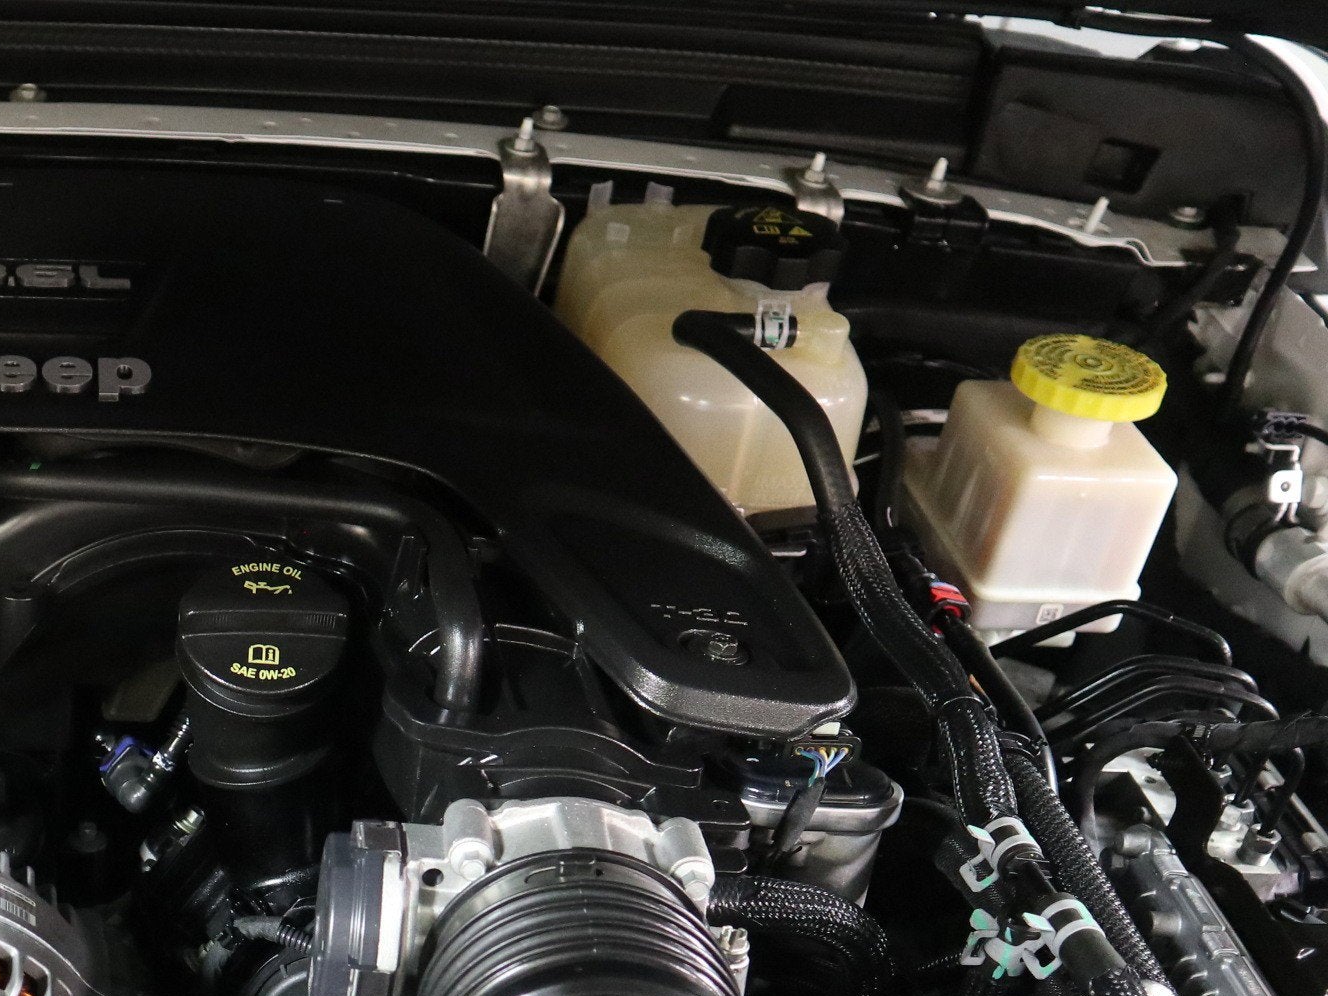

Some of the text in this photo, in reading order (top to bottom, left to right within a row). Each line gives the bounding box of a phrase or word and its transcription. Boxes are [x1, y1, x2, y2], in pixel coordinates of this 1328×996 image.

[231, 562, 304, 580] ENGINE OIL
[230, 662, 297, 680] SAE 0W-20
